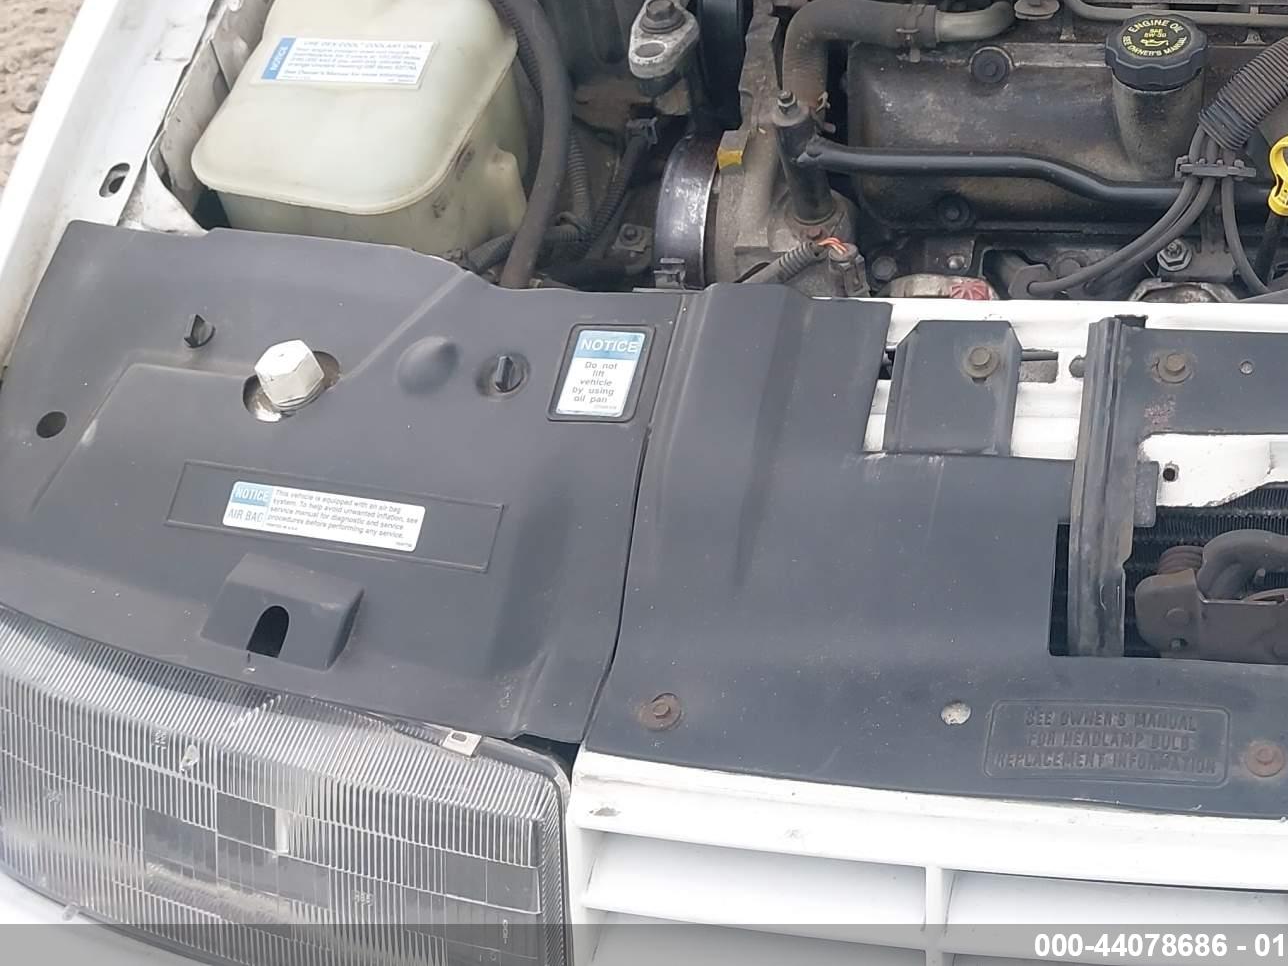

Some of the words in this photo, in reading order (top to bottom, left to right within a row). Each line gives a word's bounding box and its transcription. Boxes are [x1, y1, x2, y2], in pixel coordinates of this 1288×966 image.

[1128, 19, 1170, 33] ENGINE
[1169, 22, 1184, 33] OIL
[580, 338, 639, 353] NOTICE
[584, 361, 598, 369] Do
[602, 362, 618, 370] not
[580, 378, 613, 387] vehicle
[572, 386, 584, 395] by
[588, 387, 615, 397] using
[573, 395, 586, 403] oil
[589, 396, 608, 404] pan
[234, 488, 270, 503] NOTICE
[276, 489, 289, 497] This
[291, 492, 314, 501] vehicle
[322, 497, 353, 507] equipped
[388, 506, 402, 514] bag
[228, 508, 244, 519] AIR
[245, 511, 265, 523] BAG
[309, 502, 323, 511] help
[324, 505, 343, 513] avoid
[344, 508, 376, 518] unwanted
[267, 514, 304, 524] procedures
[305, 519, 327, 527] before
[327, 523, 364, 534] performing
[365, 529, 377, 537] any
[270, 506, 294, 514] service
[295, 509, 319, 518] manual
[330, 514, 366, 524] diagnostic
[366, 519, 379, 527] and
[380, 522, 404, 530] service
[1025, 709, 1052, 727] SEE
[1060, 711, 1126, 729] OWNER'S
[1134, 712, 1197, 732] MANUAL
[1027, 731, 1056, 747] FOR
[1063, 732, 1145, 749] HEADLAMP
[1151, 734, 1190, 752] BULB
[996, 750, 1104, 770] REPLACEMENT
[1111, 753, 1217, 775] INFORMATION
